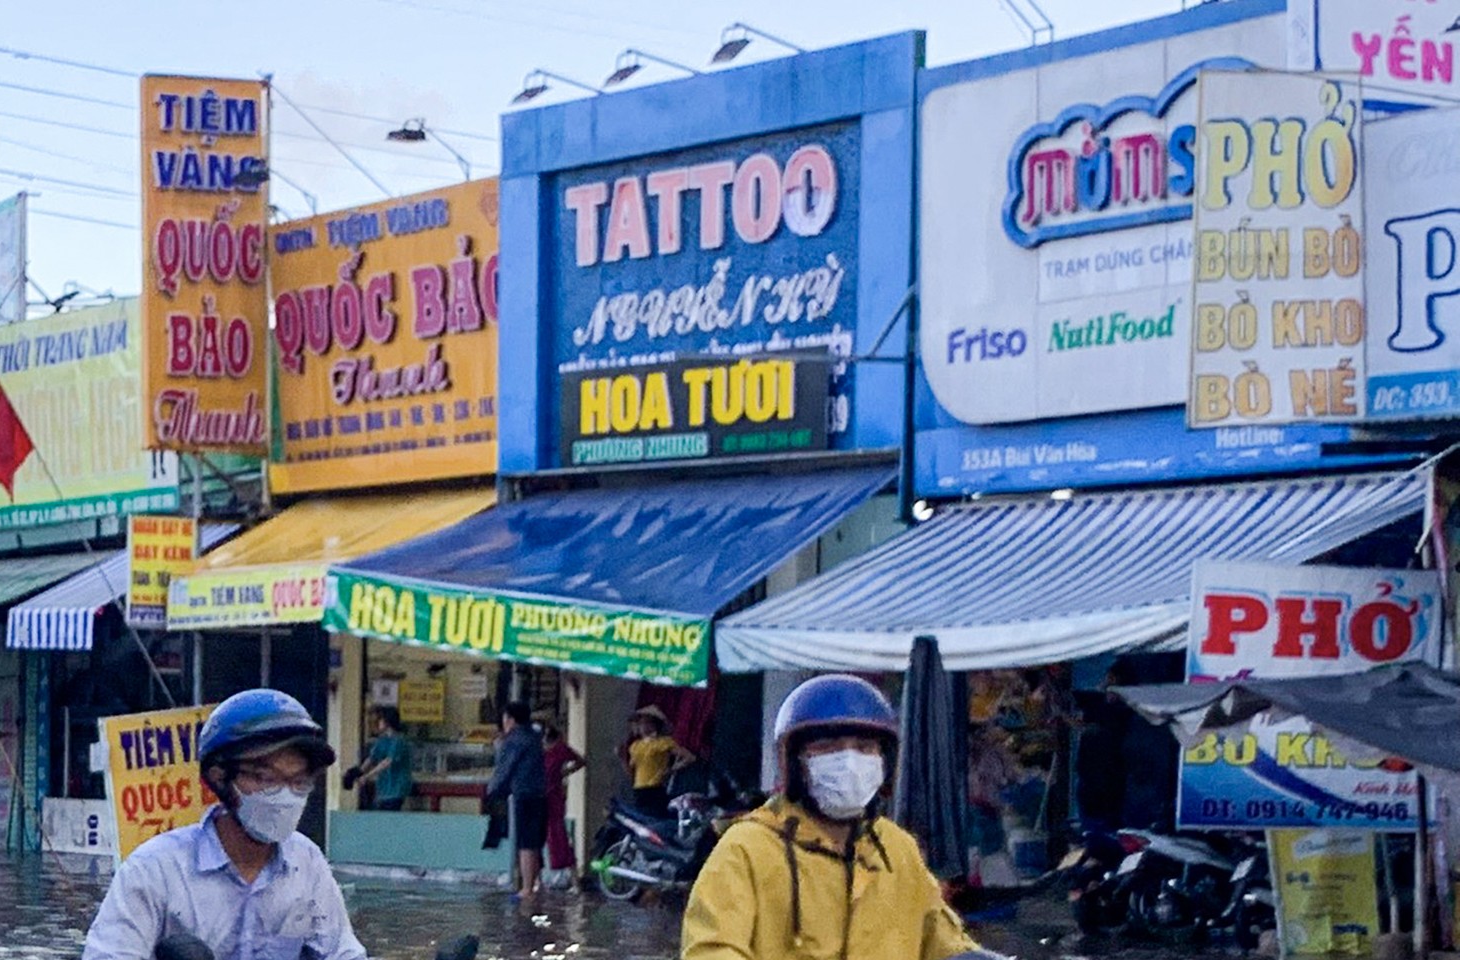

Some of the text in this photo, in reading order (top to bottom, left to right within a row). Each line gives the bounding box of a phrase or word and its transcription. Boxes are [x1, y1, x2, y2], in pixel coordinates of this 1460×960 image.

[1351, 14, 1453, 83] YẾN
[157, 89, 258, 146] TIỆM
[1201, 80, 1358, 211] PHỞ
[565, 144, 837, 267] TATTOO
[156, 200, 264, 296] QUỐC
[1198, 215, 1360, 282] BÚN BÒ
[168, 294, 252, 376] BẢO
[275, 250, 396, 374] QUỐC
[947, 302, 1178, 366] Friso NutiFood
[1196, 290, 1364, 353] BÒ KHO
[330, 342, 450, 404] Thanh
[579, 371, 673, 435] HOA
[682, 358, 796, 426] TƯƠI
[1195, 361, 1272, 423] BÒ
[155, 388, 267, 444] Thanh
[348, 583, 416, 638] HOA
[427, 592, 507, 652] TƯƠI
[611, 611, 702, 653] NHUNG
[1200, 580, 1420, 662] PHỞ
[119, 718, 177, 777] TIỆM
[121, 767, 193, 823] QUỐC
[1246, 798, 1306, 821] 0914
